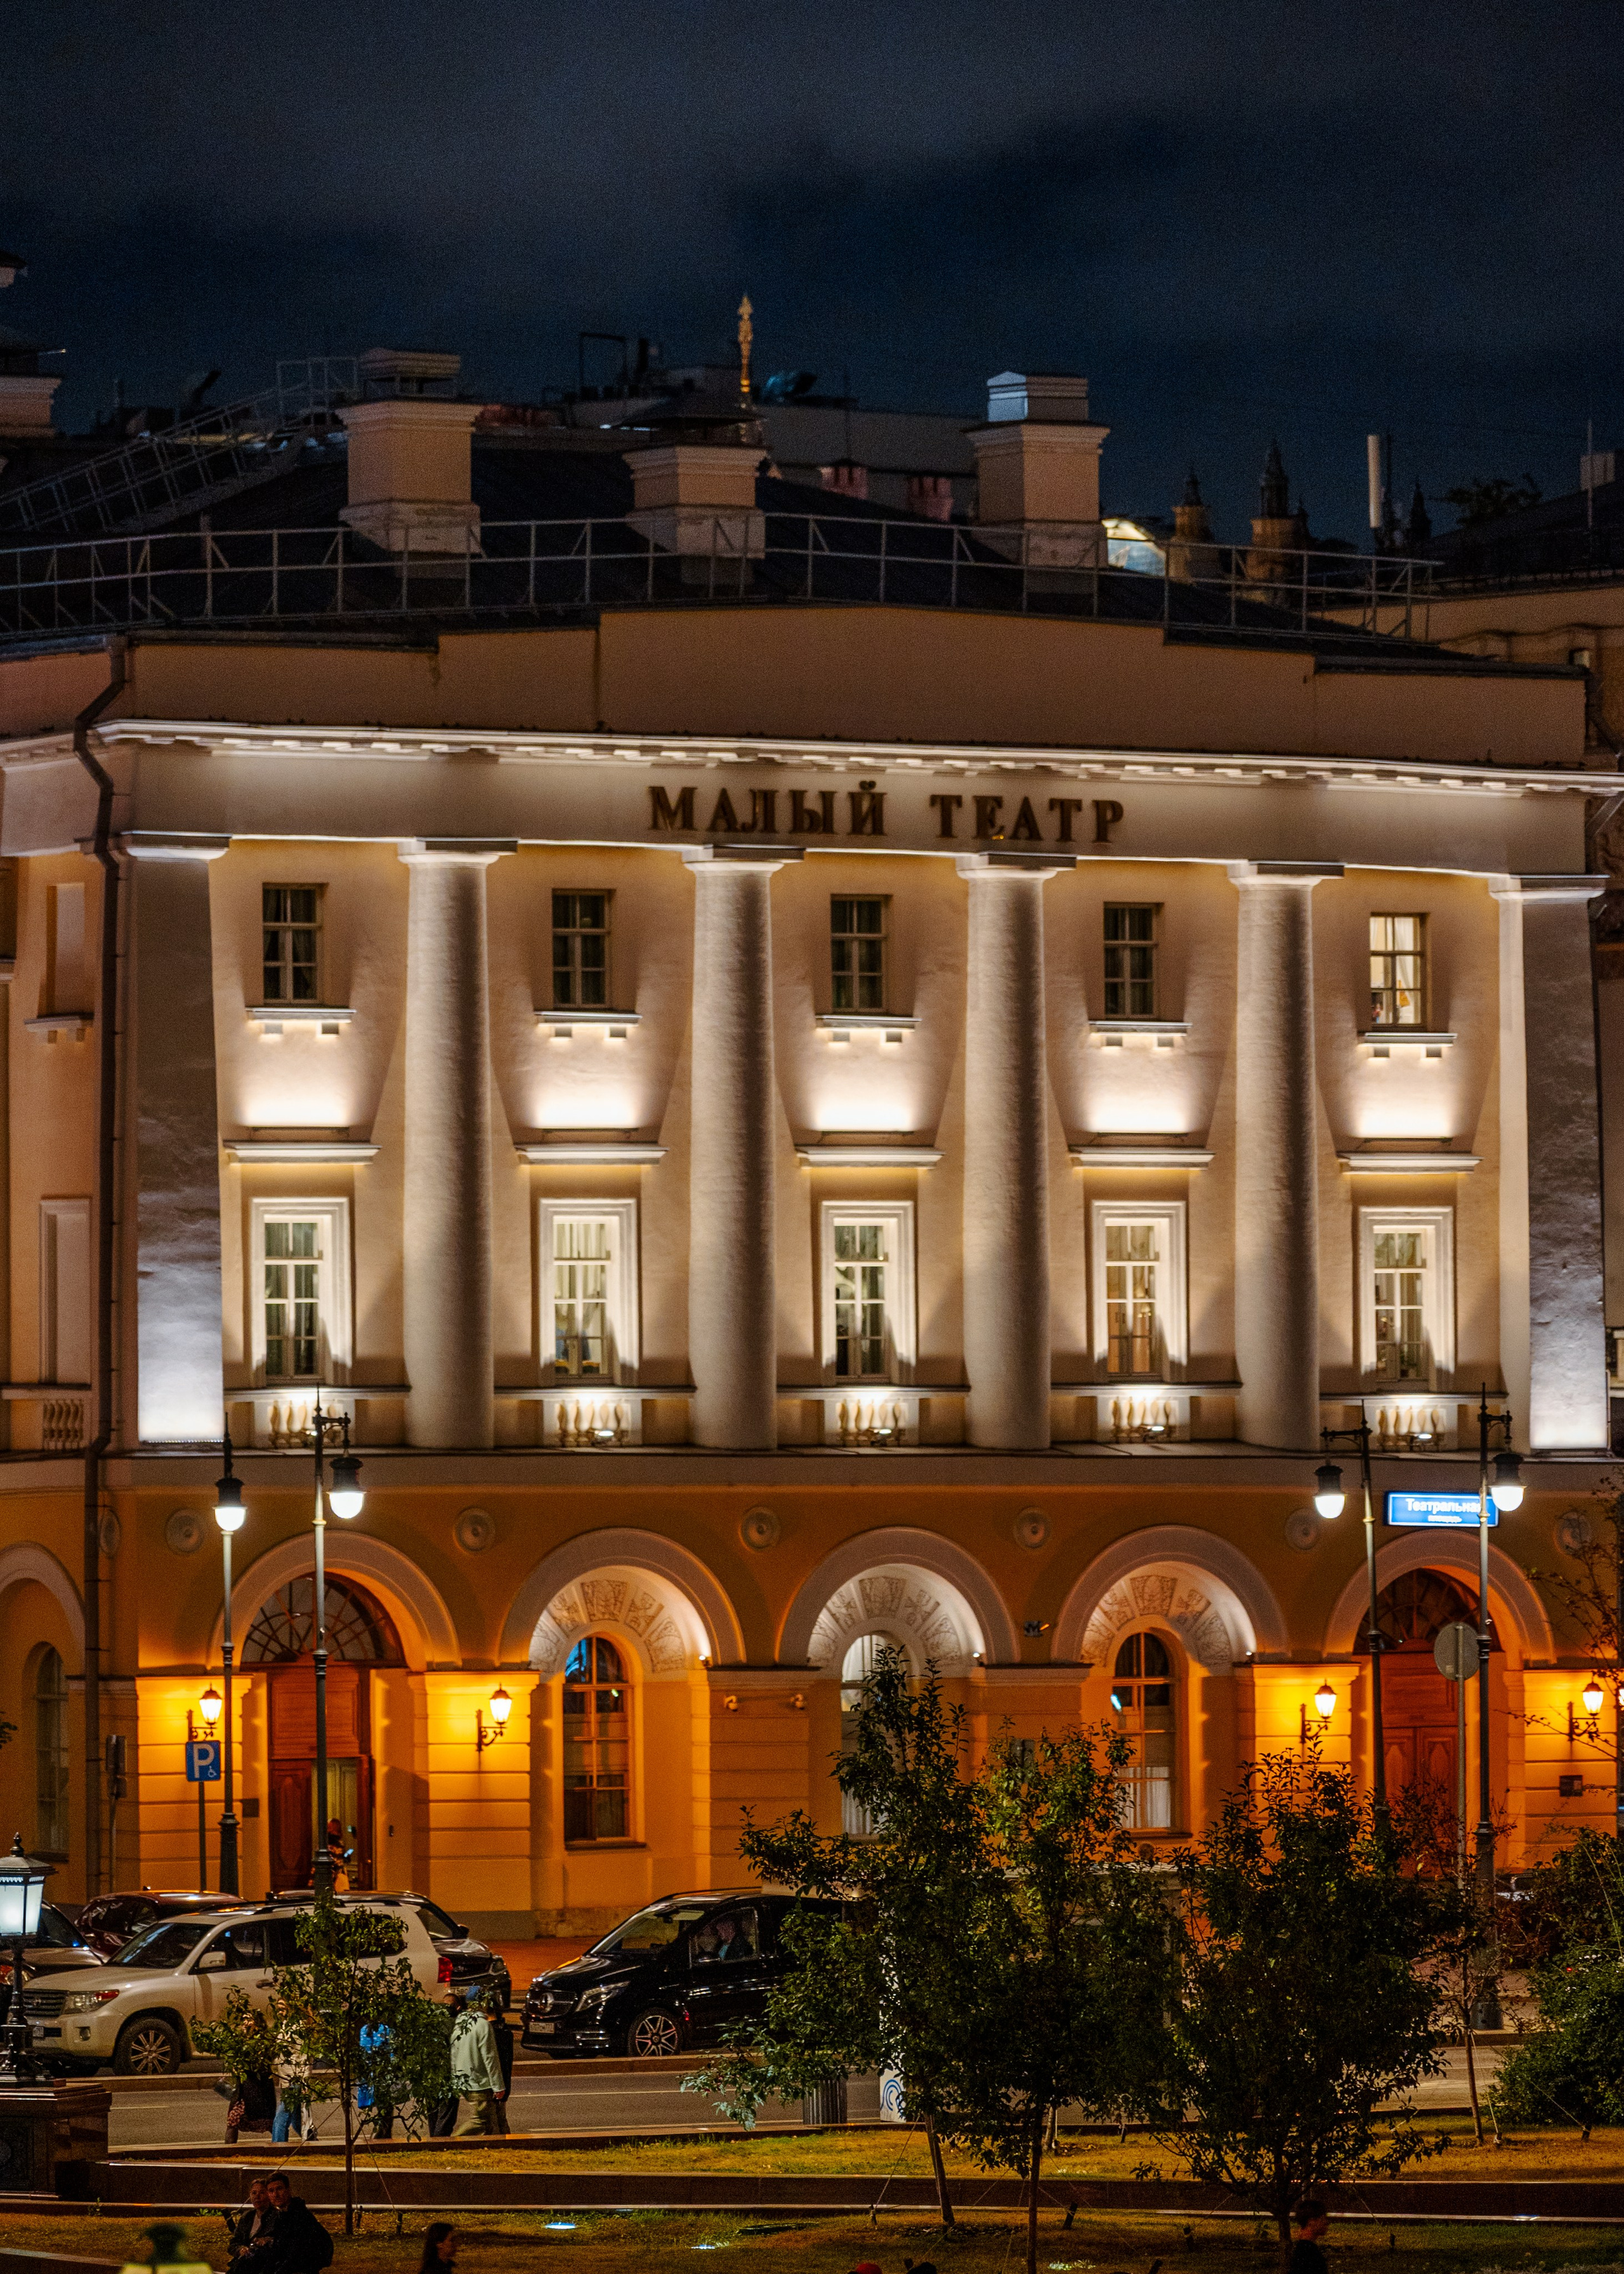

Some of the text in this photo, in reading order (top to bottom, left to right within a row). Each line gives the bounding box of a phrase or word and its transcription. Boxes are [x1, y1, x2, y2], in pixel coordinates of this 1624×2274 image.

[648, 780, 1124, 843] МАЛЫЙ ТЕАТР
[193, 1743, 215, 1778] P
